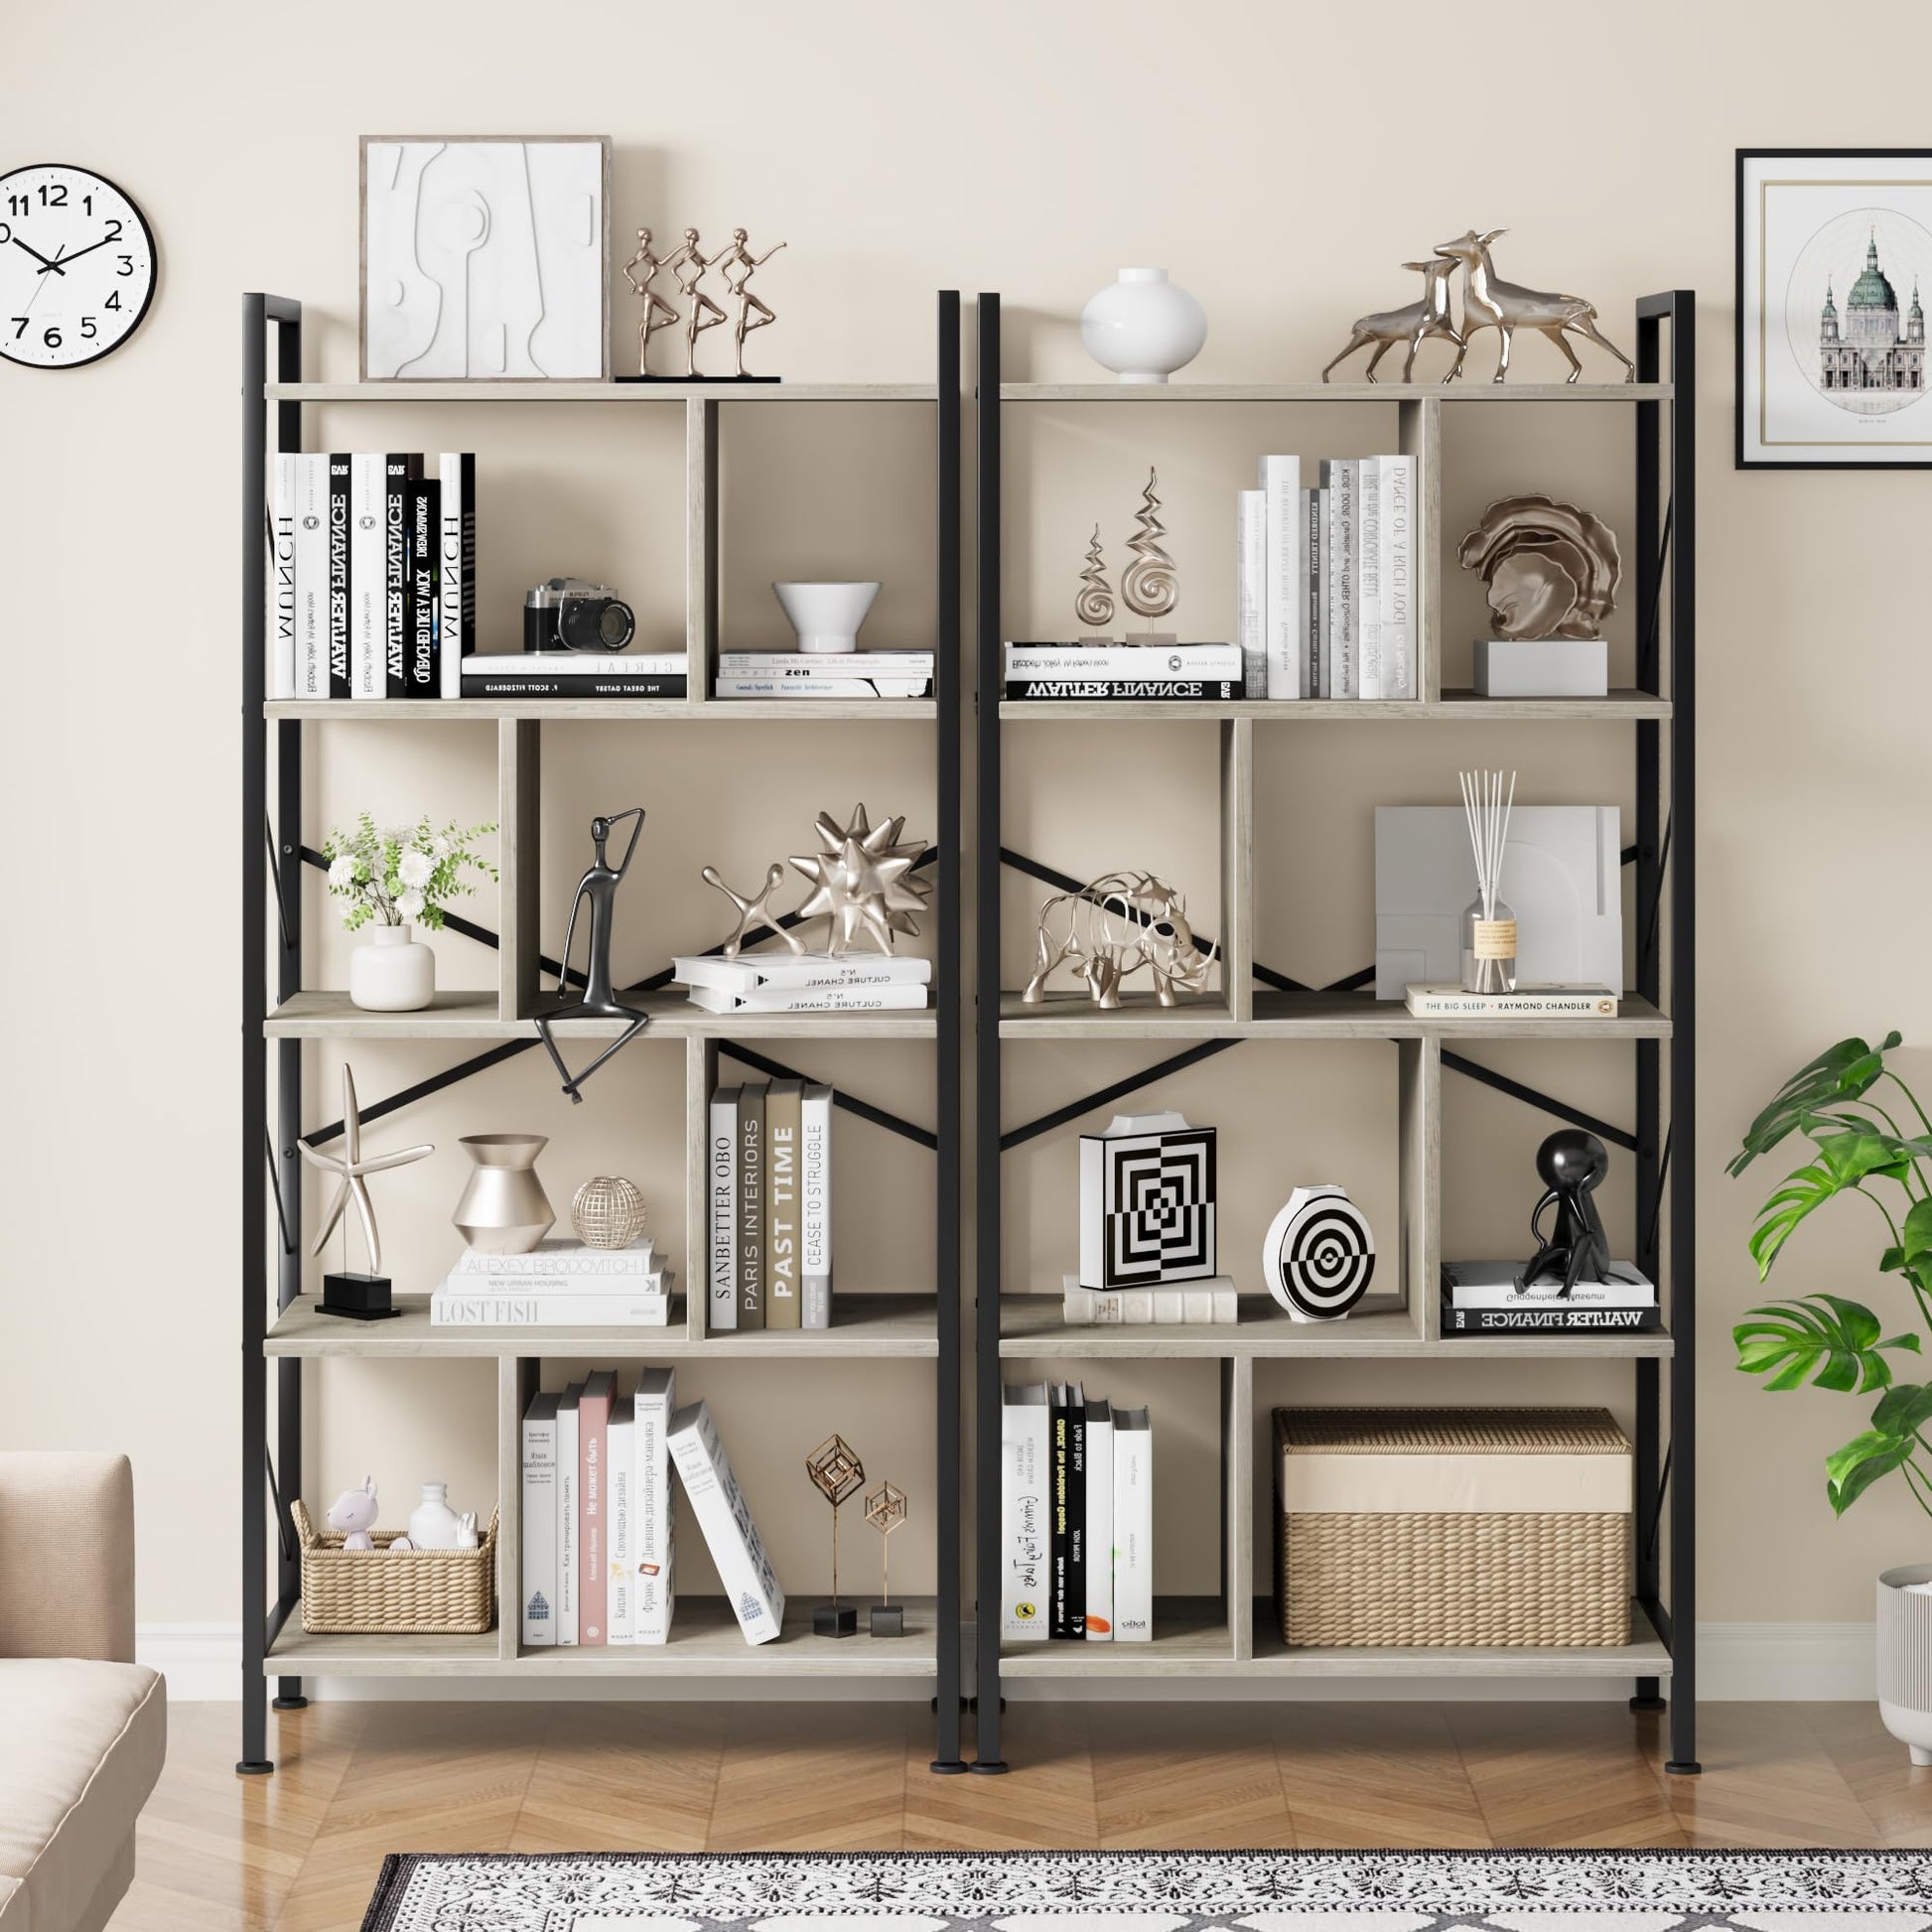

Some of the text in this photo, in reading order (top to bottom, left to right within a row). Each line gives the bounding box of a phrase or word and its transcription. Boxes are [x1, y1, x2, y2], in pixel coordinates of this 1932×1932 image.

[8, 195, 29, 216] 11
[38, 185, 69, 207] 12
[82, 195, 92, 216] 1
[104, 219, 123, 241] 2
[116, 255, 134, 277] 3
[104, 290, 122, 312] 4
[11, 317, 30, 340] 7
[44, 327, 63, 348] 6
[80, 317, 97, 339] 5
[807, 1124, 822, 1192] STRUGGLE
[715, 1136, 731, 1300] SANBETTER OBO
[745, 1119, 758, 1311] PARIS INTERIORS
[774, 1127, 793, 1299] PAST TIME
[807, 1199, 822, 1216] TO
[807, 1221, 822, 1266] CEASE
[467, 1258, 636, 1273] ALEXEY BRODOVITCH
[439, 1300, 539, 1323] LOST FISH
[587, 1438, 599, 1515] Не может быть
[642, 1517, 656, 1560] Дневник
[617, 1587, 626, 1619] Каплан
[642, 1582, 657, 1613] Франк
